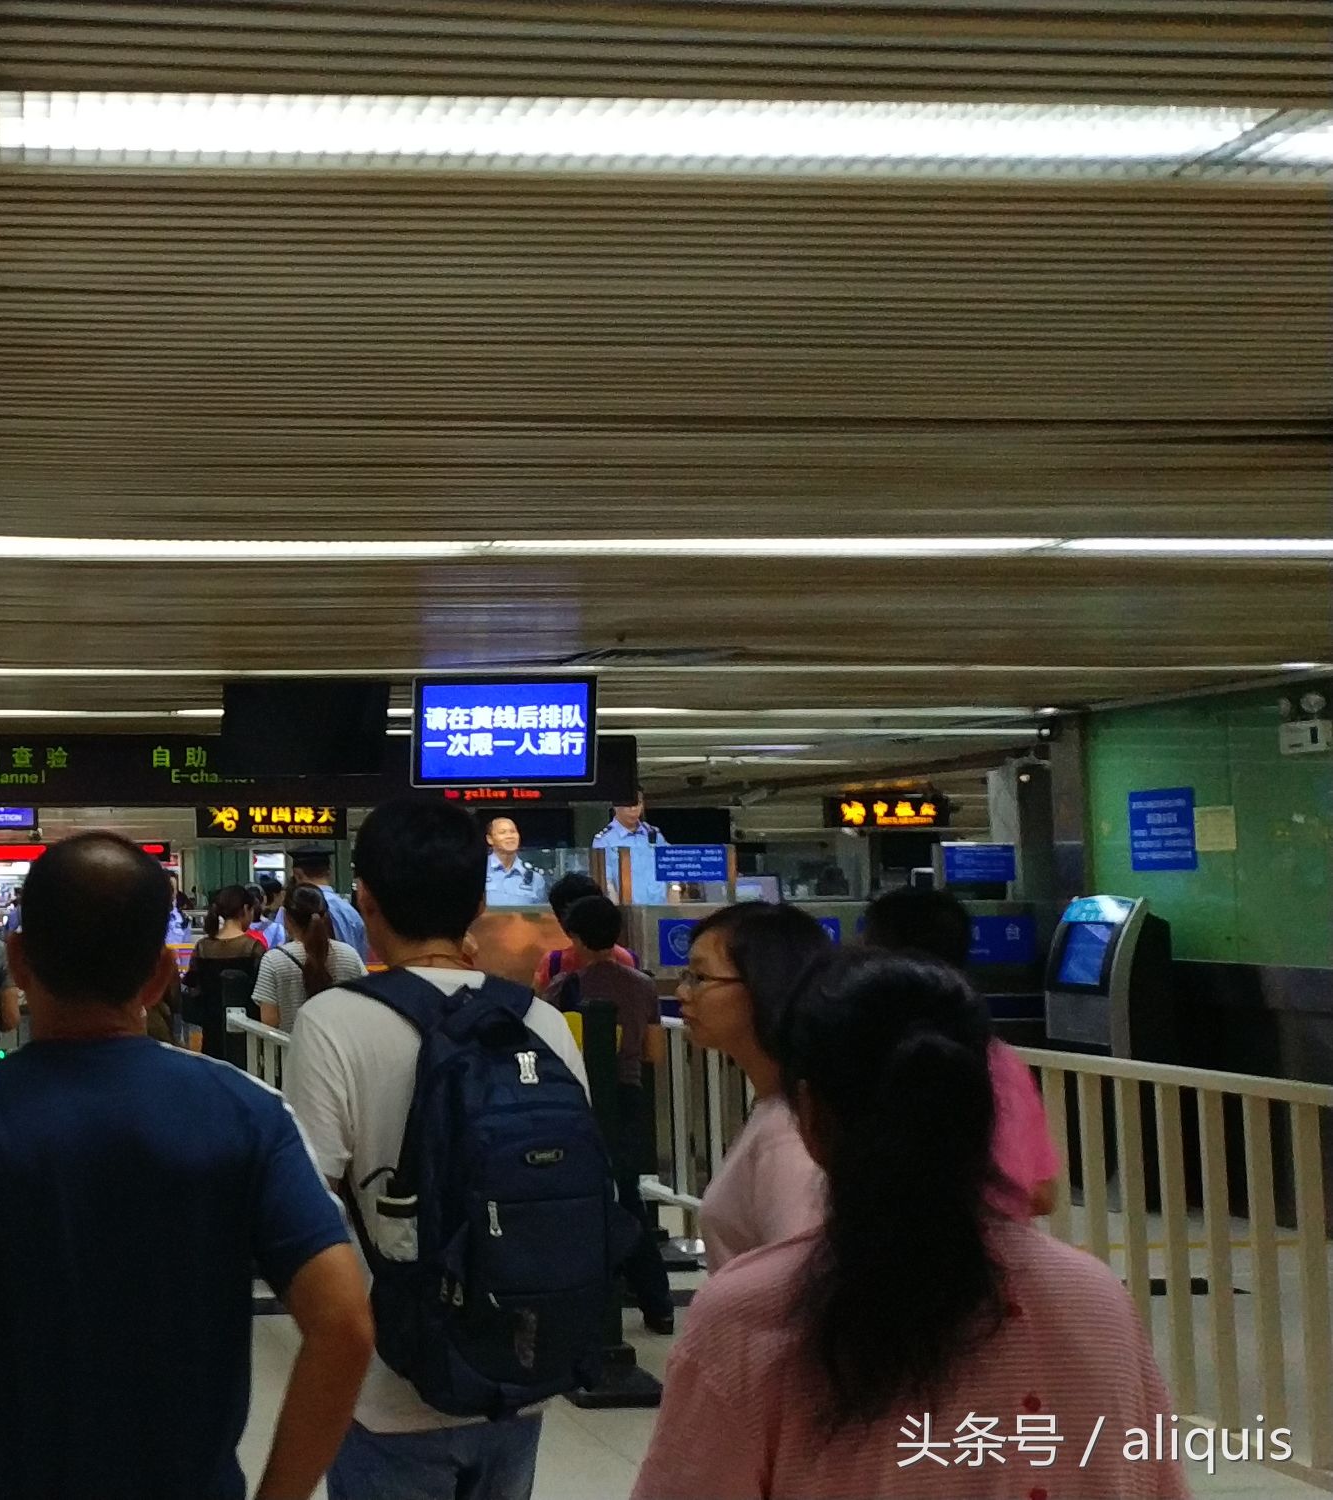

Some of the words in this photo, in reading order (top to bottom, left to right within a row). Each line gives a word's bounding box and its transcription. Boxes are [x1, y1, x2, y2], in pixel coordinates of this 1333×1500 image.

[424, 704, 585, 730] 请在黄线后排队
[423, 732, 585, 756] 一次限一人通行
[464, 789, 507, 800] yellow
[513, 789, 541, 798] line
[251, 824, 284, 834] CHINA
[287, 824, 334, 834] CUSTOMS
